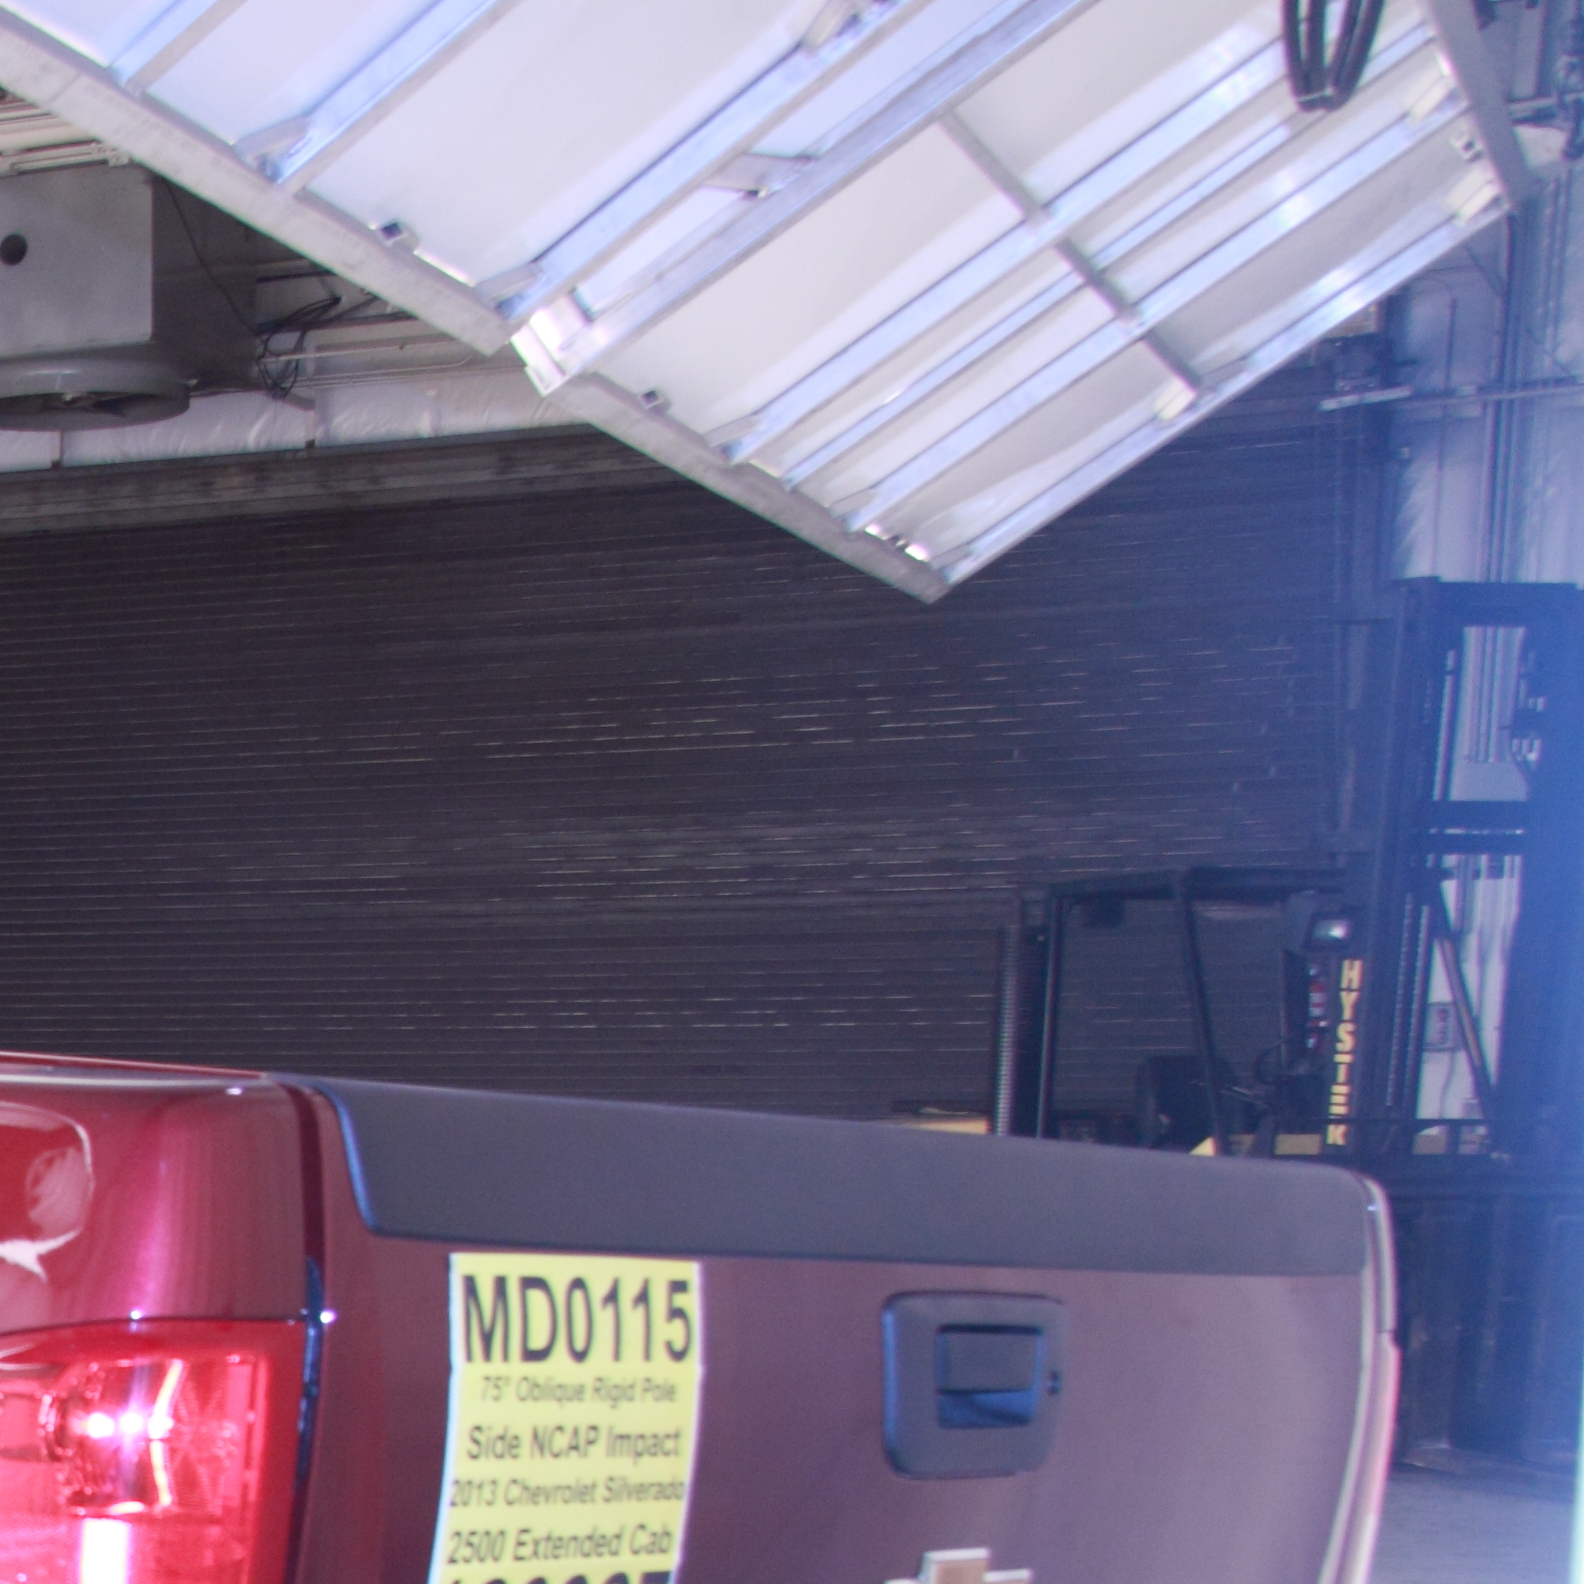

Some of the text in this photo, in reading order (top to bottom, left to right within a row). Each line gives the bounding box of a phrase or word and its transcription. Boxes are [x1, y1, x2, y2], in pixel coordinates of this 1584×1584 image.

[462, 1274, 693, 1364] MD0115
[516, 1376, 586, 1409] Oblique
[590, 1378, 636, 1409] Rigid
[640, 1379, 677, 1404] Pole
[467, 1424, 682, 1467] Side NCAP Impact
[450, 1477, 686, 1508] 2013 Chevrolet Silverado
[447, 1523, 672, 1565] 2500 Extended Cab
